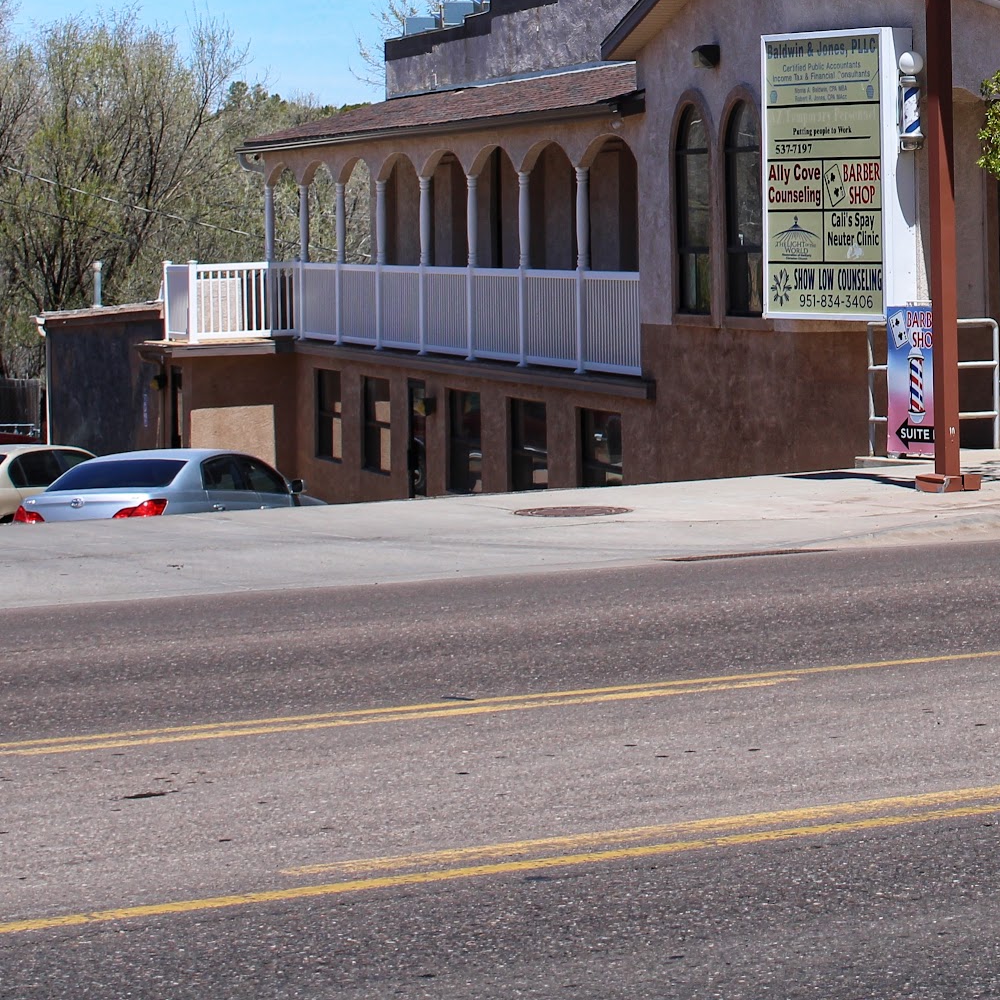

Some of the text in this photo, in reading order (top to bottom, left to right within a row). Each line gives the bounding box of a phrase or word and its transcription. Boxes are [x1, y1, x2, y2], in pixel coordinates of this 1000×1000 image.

[767, 37, 876, 59] Baldwin & Jones, PLLC
[782, 61, 861, 72] Certified Public Accountants
[793, 73, 803, 81] Tax
[805, 72, 809, 80] &
[810, 72, 835, 80] Financial
[792, 127, 812, 136] Putting
[813, 126, 830, 136] people
[838, 126, 852, 134] Work
[775, 143, 812, 154] 537-7197
[768, 163, 821, 185] Ally Cove
[843, 162, 880, 182] BARBER
[768, 186, 821, 206] Counseling
[849, 185, 876, 205] SHOP
[831, 212, 875, 230] Cali's Spay
[827, 231, 880, 246] Neuter Clinic
[794, 268, 882, 291] SHOW LOW COUNSELING
[799, 293, 874, 309] 951-834-3406
[906, 311, 932, 328] BARB
[912, 331, 932, 348] SHO
[900, 427, 930, 440] SUITE
